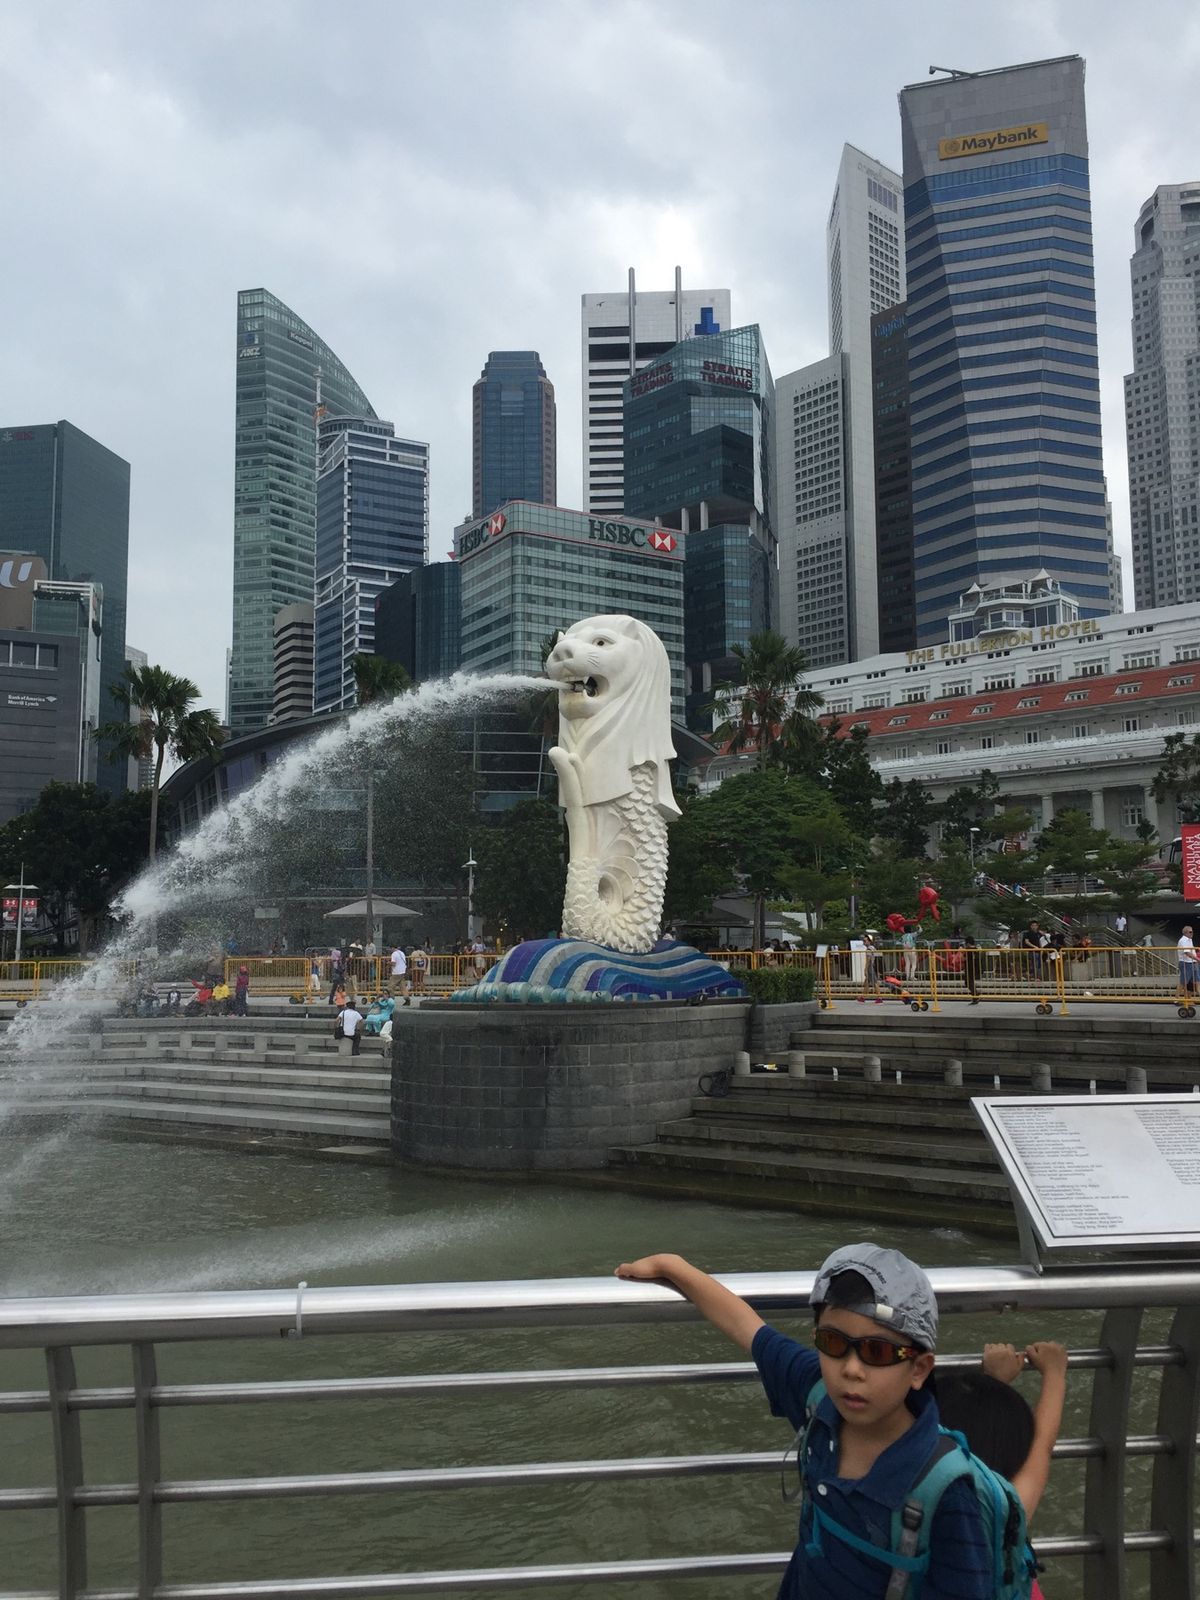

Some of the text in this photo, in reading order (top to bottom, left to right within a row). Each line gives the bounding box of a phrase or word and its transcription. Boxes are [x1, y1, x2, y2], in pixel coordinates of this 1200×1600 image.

[961, 127, 1038, 151] Maybank
[240, 346, 260, 358] ANZ
[630, 361, 672, 387] STRAITS
[701, 371, 752, 390] TRADING
[703, 360, 752, 379] STRAITS
[631, 372, 673, 397] TRADING
[459, 522, 489, 557] HSBC
[588, 518, 646, 547] HSBC
[905, 619, 1101, 665] THE FULLERTON HOTEL
[1185, 836, 1196, 884] MAJULAH
